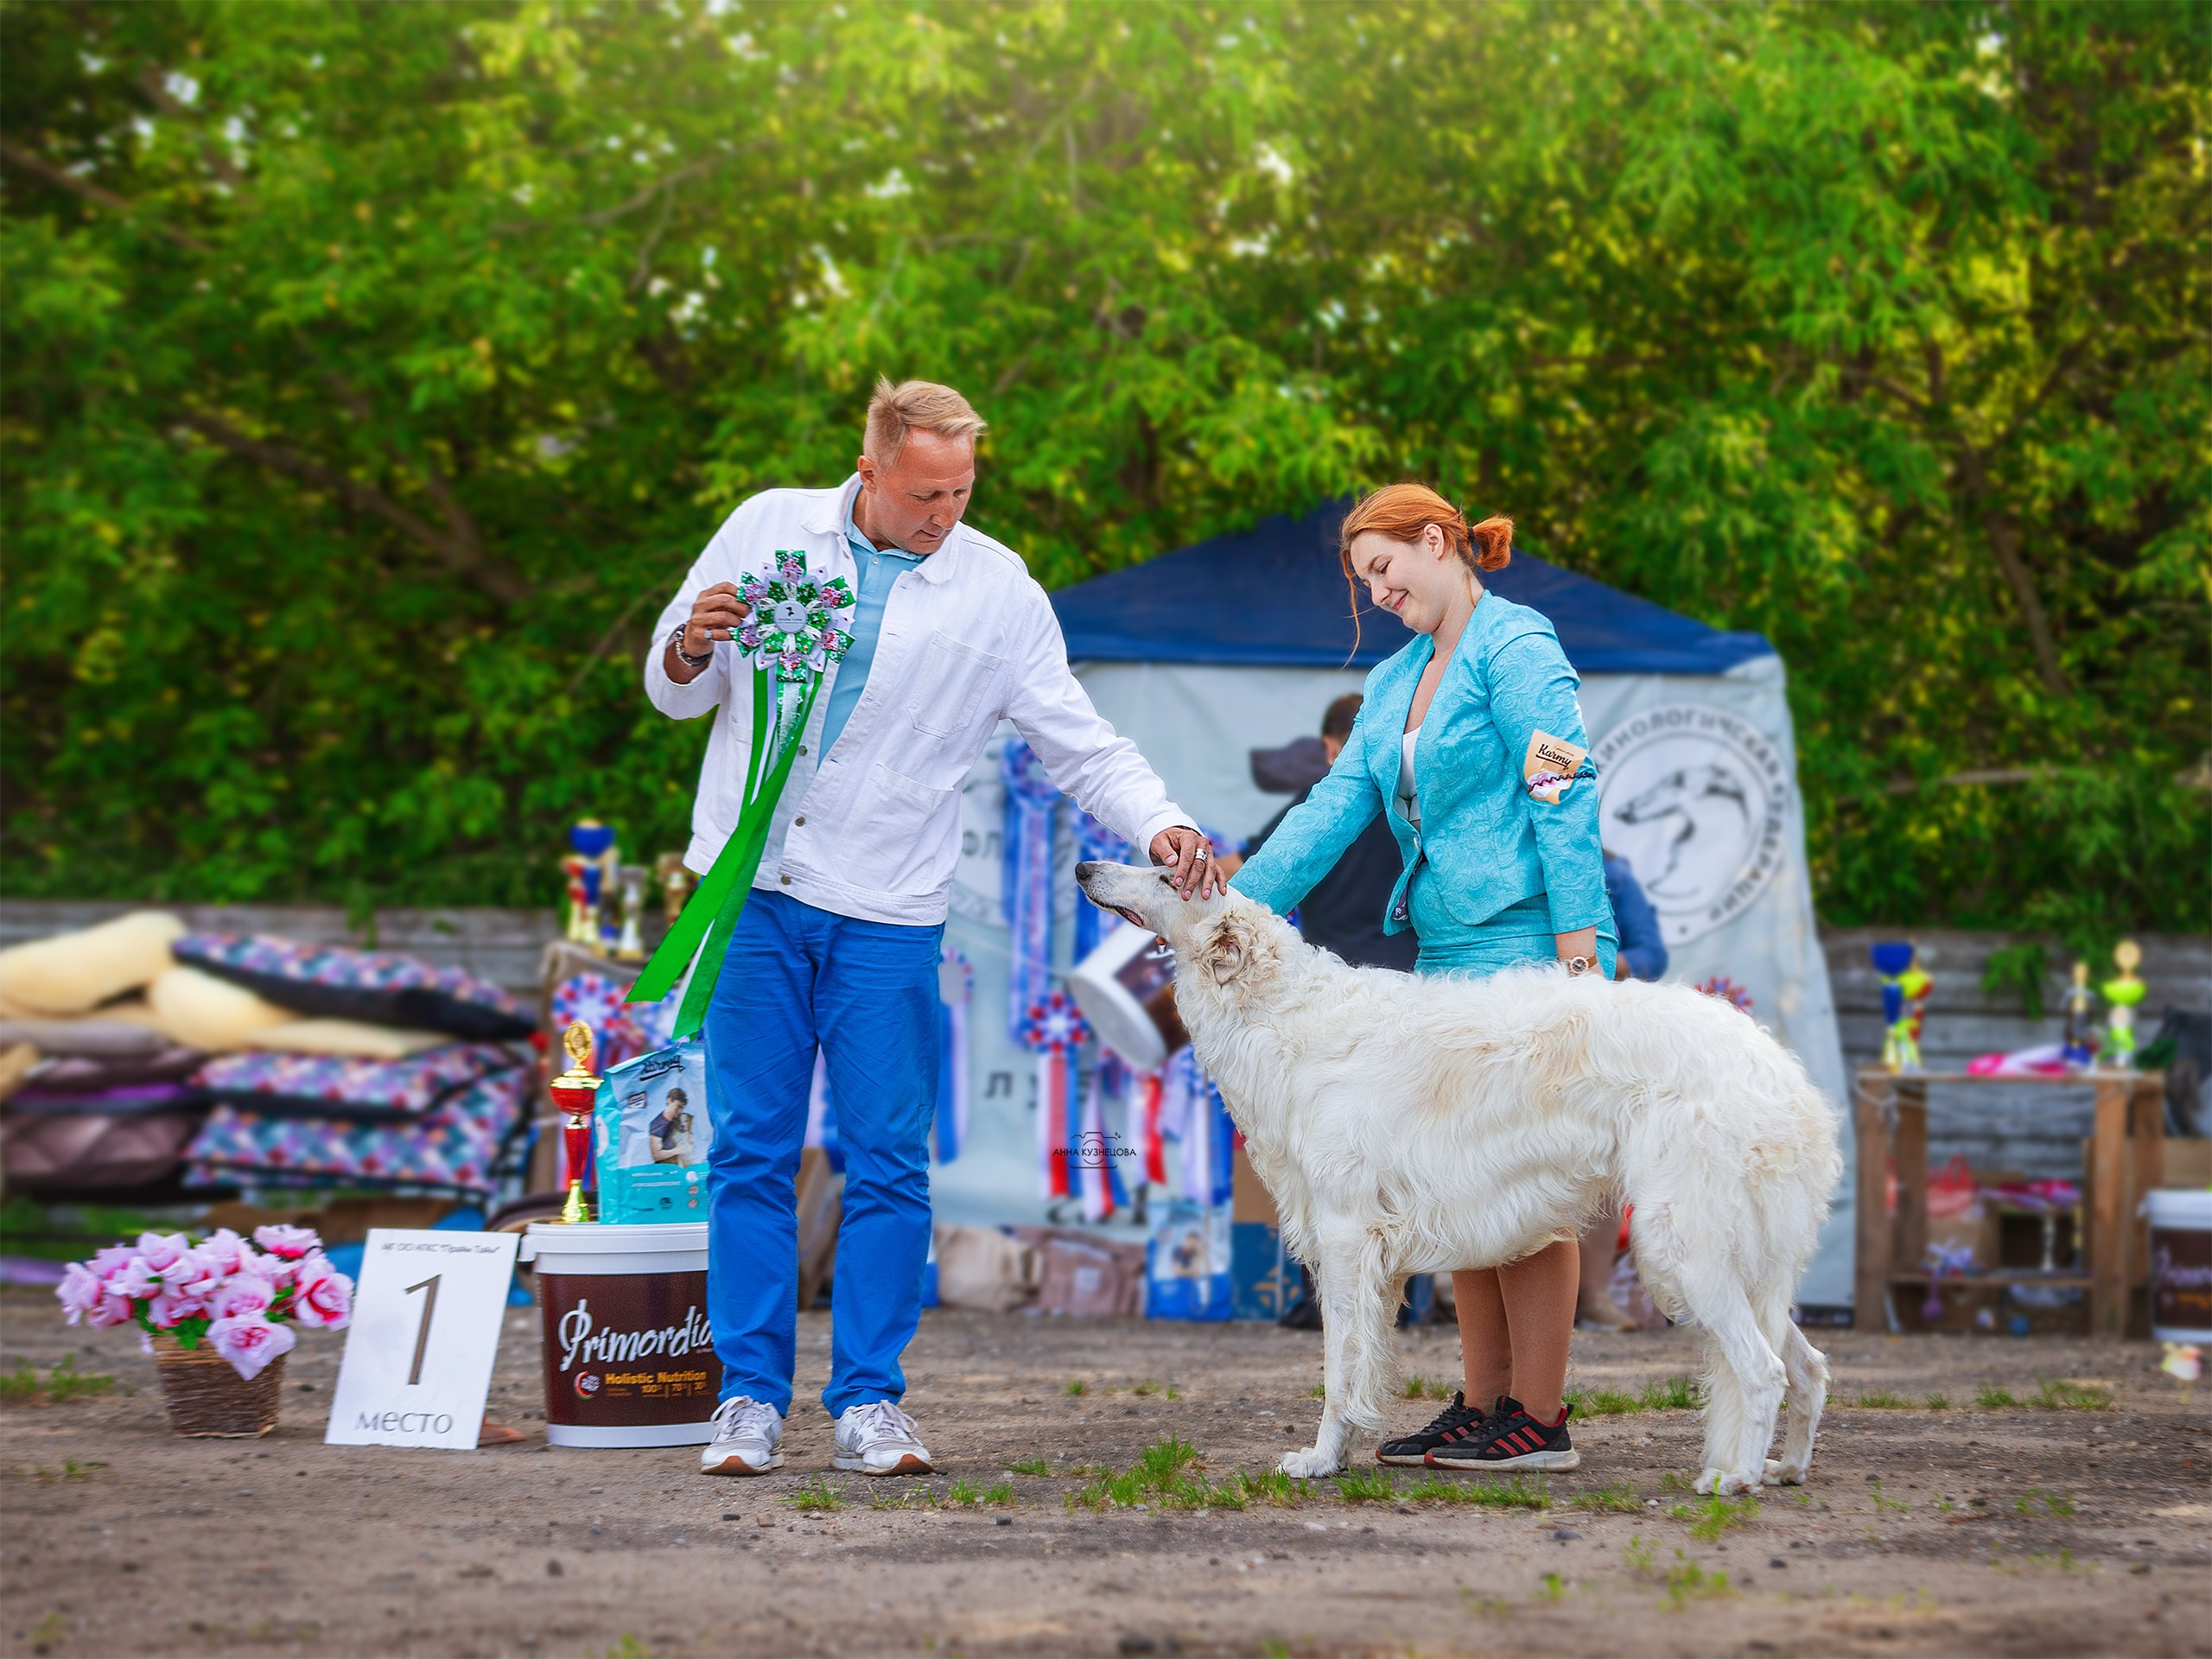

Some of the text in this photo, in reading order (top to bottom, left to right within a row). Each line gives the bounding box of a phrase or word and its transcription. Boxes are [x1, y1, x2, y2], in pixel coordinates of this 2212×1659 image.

[1535, 743, 1572, 771] Karmy
[404, 1274, 442, 1385] 1
[557, 1299, 714, 1372] Primordia
[606, 1372, 655, 1385] Holistic
[658, 1370, 706, 1383] Nutrition
[354, 1411, 453, 1434] место
